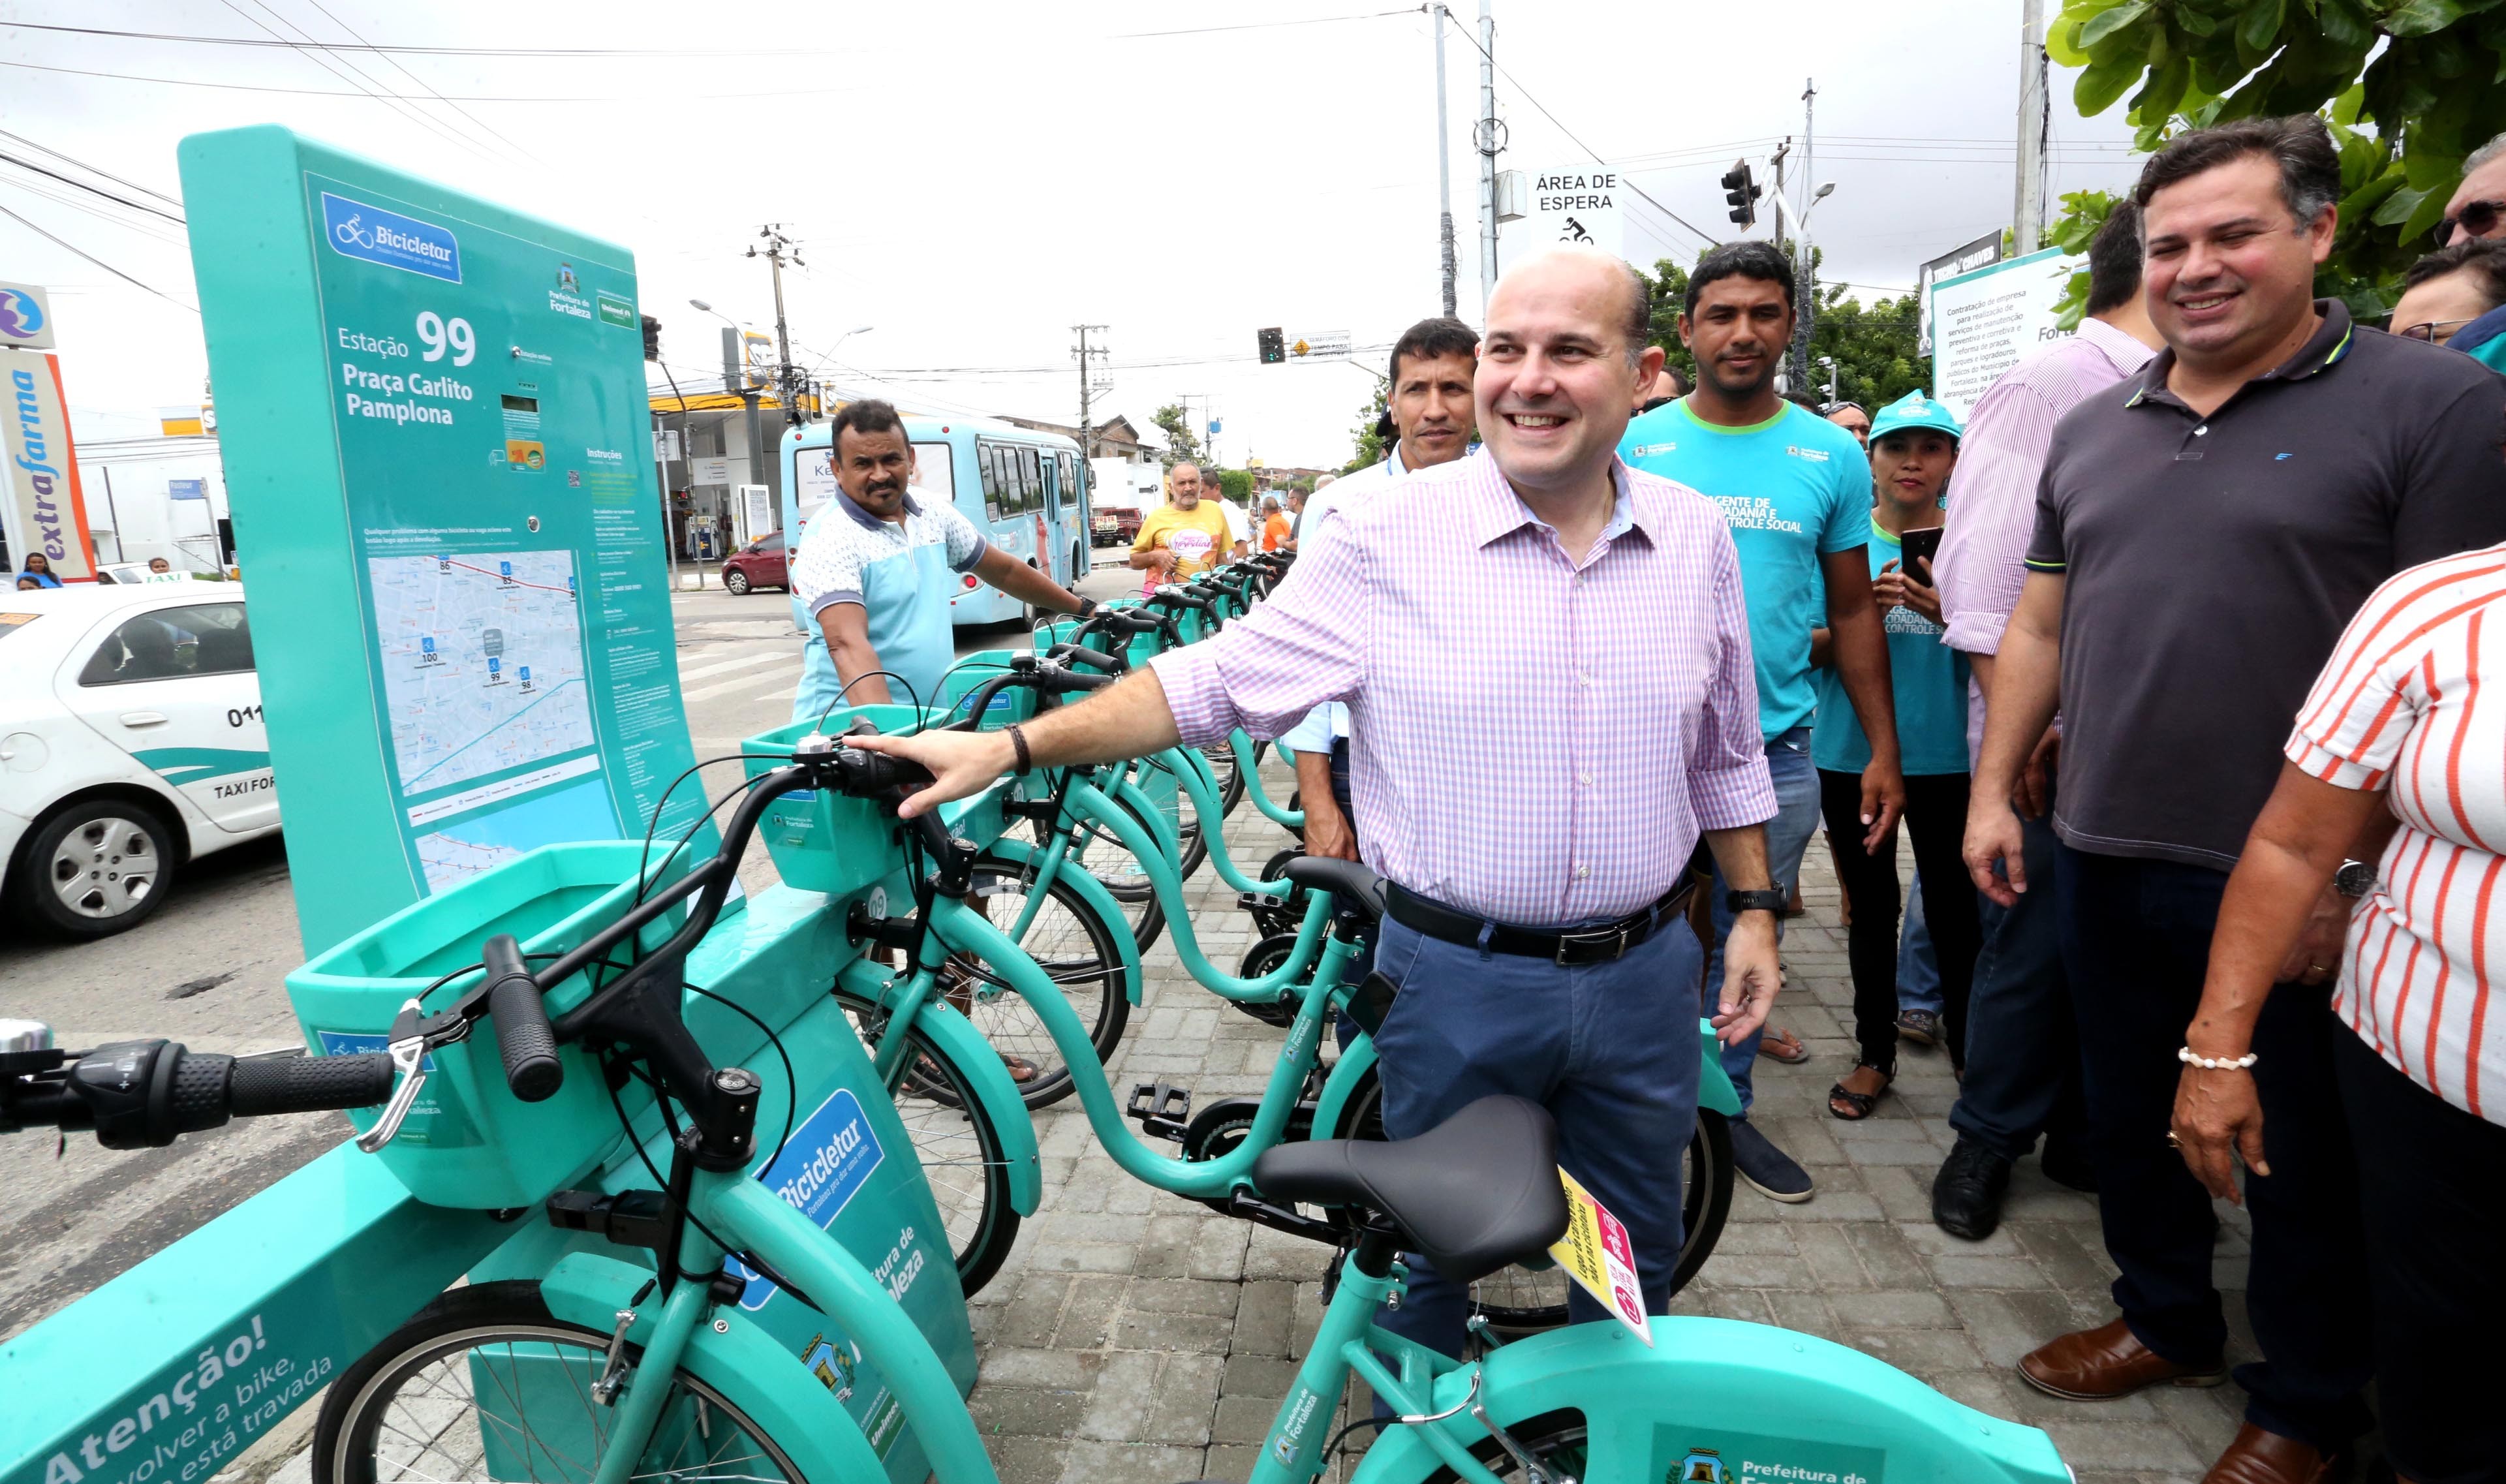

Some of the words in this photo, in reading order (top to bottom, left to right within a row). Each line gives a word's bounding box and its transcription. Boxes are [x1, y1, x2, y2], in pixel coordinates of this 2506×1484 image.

[1536, 174, 1586, 191] ÁREA
[1593, 174, 1616, 188] DE
[1540, 195, 1613, 210] ESPERA
[376, 226, 452, 261] Bicicletar
[1963, 245, 1994, 272] CHAVES
[549, 290, 580, 305] Prefeitura
[1947, 300, 1986, 316] Contratação
[1996, 290, 2026, 302] empresa
[550, 300, 591, 319] Fortaleza
[1957, 316, 1971, 326] para
[1972, 306, 2003, 320] realização
[1948, 326, 1973, 337] serviços
[1984, 313, 2023, 328] manutenção
[338, 328, 409, 359] Estação
[416, 311, 476, 367] 99
[1949, 334, 1980, 348] preventiva
[1987, 326, 2015, 338] corretiva
[1951, 357, 1973, 367] parques
[1980, 348, 2017, 362] logradouros
[1956, 346, 1979, 355] reforma
[1981, 360, 2010, 371] Município
[343, 363, 404, 397] Praça
[409, 373, 472, 401] Carlito
[1944, 388, 1977, 398] abrangência
[347, 393, 453, 425] Pamplona
[587, 448, 622, 459] Instruções
[12, 369, 65, 561] extrafarma
[1708, 495, 1751, 508] AGENTE
[1755, 498, 1771, 509] DE
[1770, 508, 1776, 519] E
[1766, 519, 1802, 533] SOCIAL
[440, 561, 450, 570] 86
[147, 574, 180, 583] TAXI
[1885, 624, 1934, 634] CONTROLE
[422, 653, 437, 662] 100
[491, 673, 500, 681] 99
[522, 681, 531, 689] 98
[214, 781, 248, 799] TAXI
[870, 894, 884, 918] 09
[1295, 1018, 1312, 1047] Fortaleza
[1578, 1203, 1592, 1247] ciclofaixa
[900, 1227, 914, 1249] de
[1572, 1241, 1583, 1252] de
[1577, 1251, 1588, 1280] Lugar
[45, 1314, 266, 1484] Atenção!
[215, 1402, 230, 1423] a
[236, 1357, 294, 1407] bike,
[181, 1425, 236, 1481] está
[242, 1355, 332, 1434] travada
[1284, 1398, 1304, 1432] Prefeitura
[1301, 1388, 1308, 1399] de
[1290, 1395, 1318, 1440] Fortaleza
[1742, 1461, 1837, 1483] Prefeitura
[1842, 1472, 1867, 1484] de
